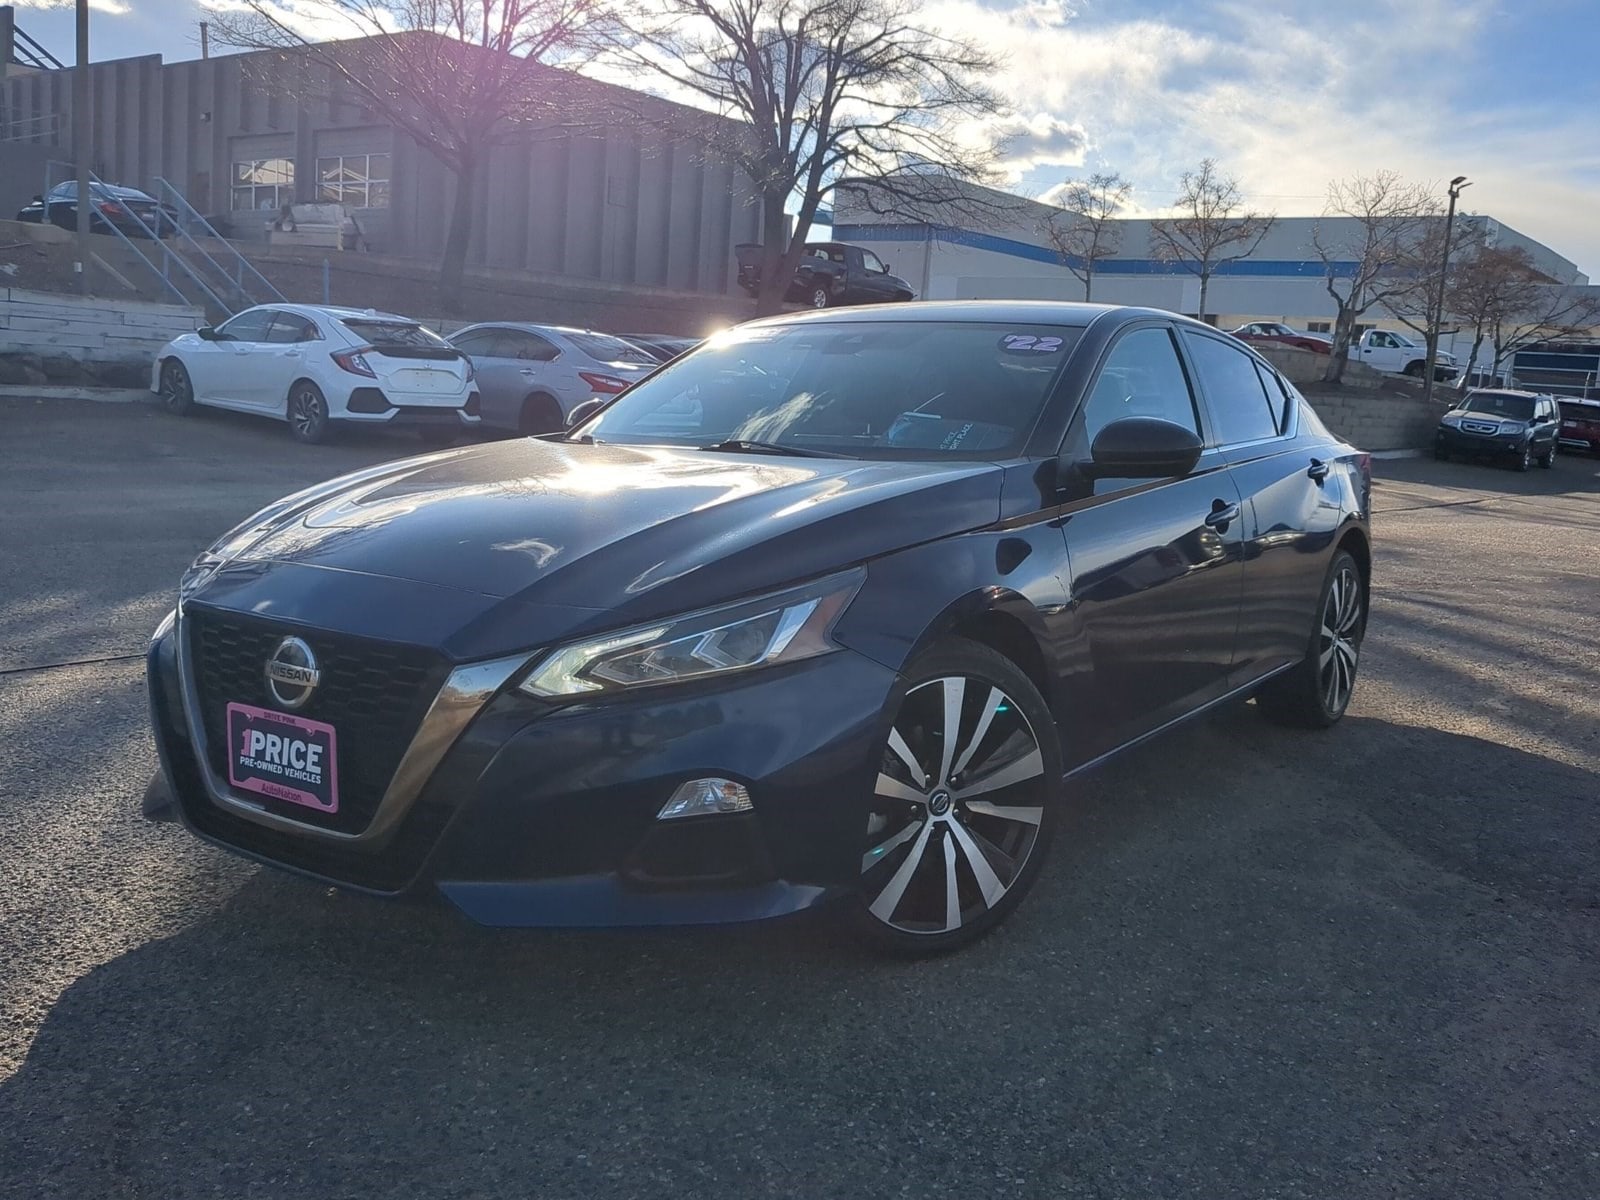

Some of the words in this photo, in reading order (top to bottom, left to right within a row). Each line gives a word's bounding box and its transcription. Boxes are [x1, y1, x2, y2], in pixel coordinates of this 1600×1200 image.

[270, 664, 312, 683] NISSAN
[263, 711, 281, 722] DRIVE
[239, 755, 283, 774] PRE-OWNED
[284, 767, 322, 785] VEHICLES
[260, 782, 302, 802] AutoNation
